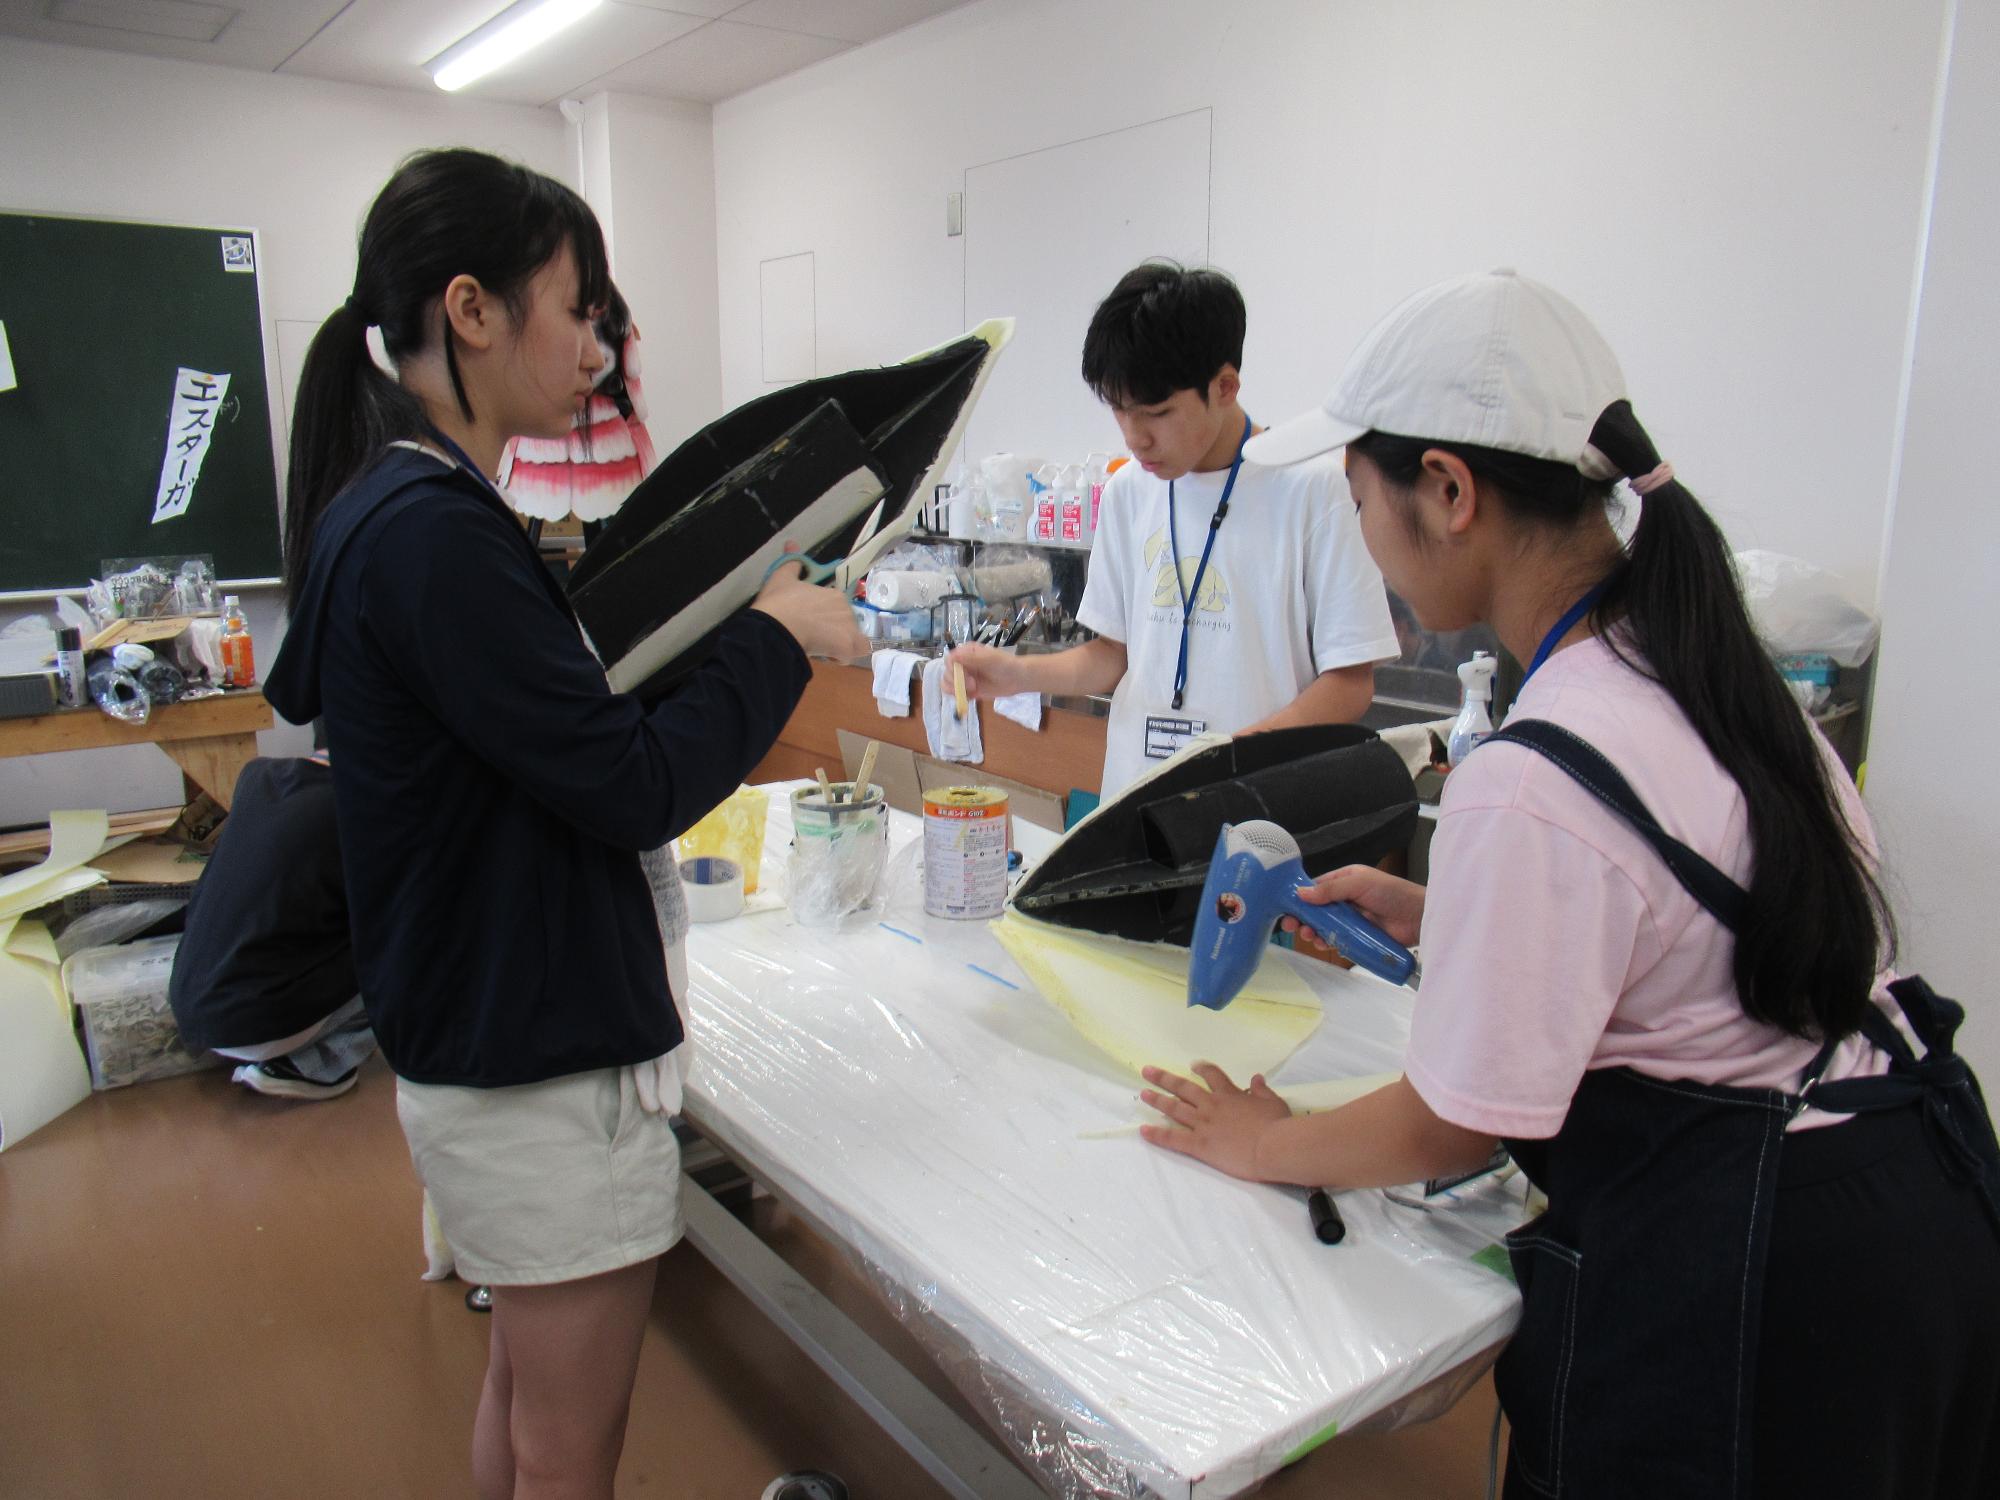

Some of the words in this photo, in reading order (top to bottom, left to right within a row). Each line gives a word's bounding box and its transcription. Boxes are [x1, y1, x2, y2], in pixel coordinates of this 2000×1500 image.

[160, 379, 218, 509] エスターガ
